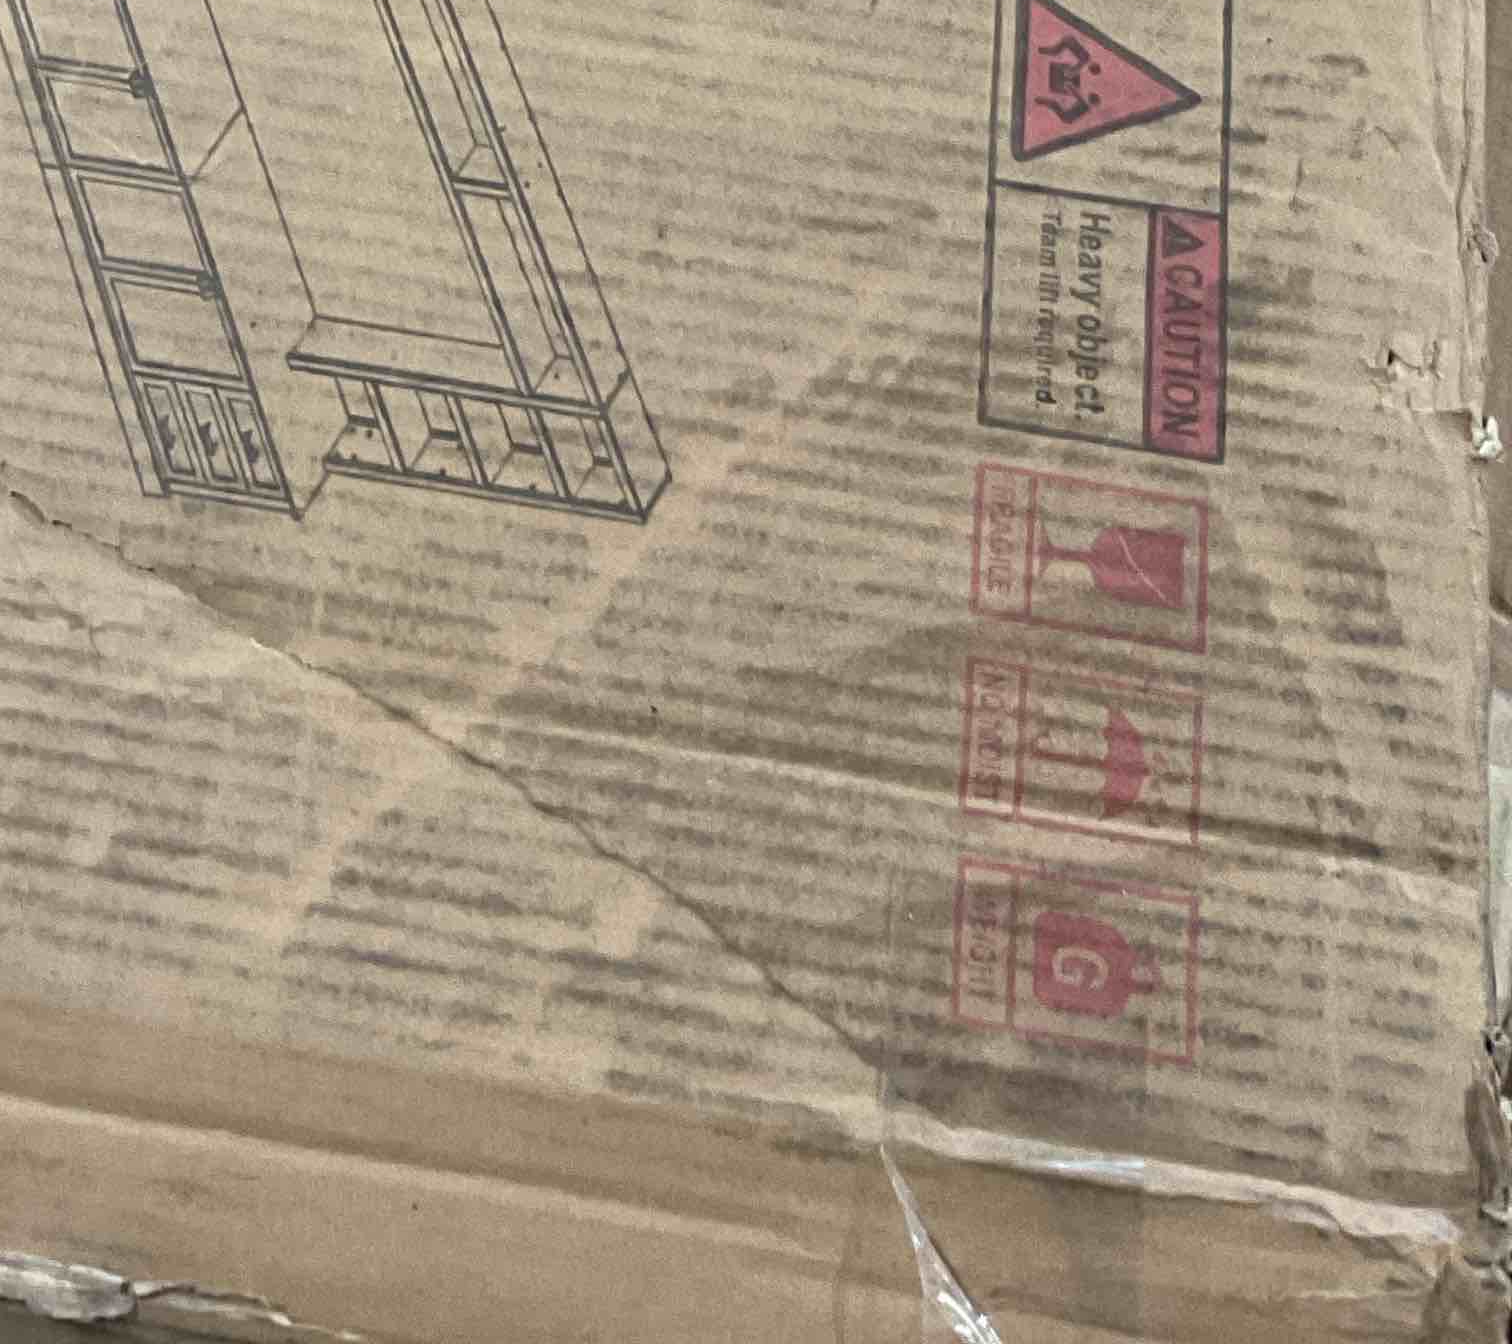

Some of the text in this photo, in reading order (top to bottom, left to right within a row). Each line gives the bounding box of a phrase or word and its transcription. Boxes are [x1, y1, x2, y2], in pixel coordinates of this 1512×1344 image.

[1039, 211, 1062, 264] Team
[1071, 212, 1110, 420] Heavy object.
[1162, 265, 1203, 438] CAUTION
